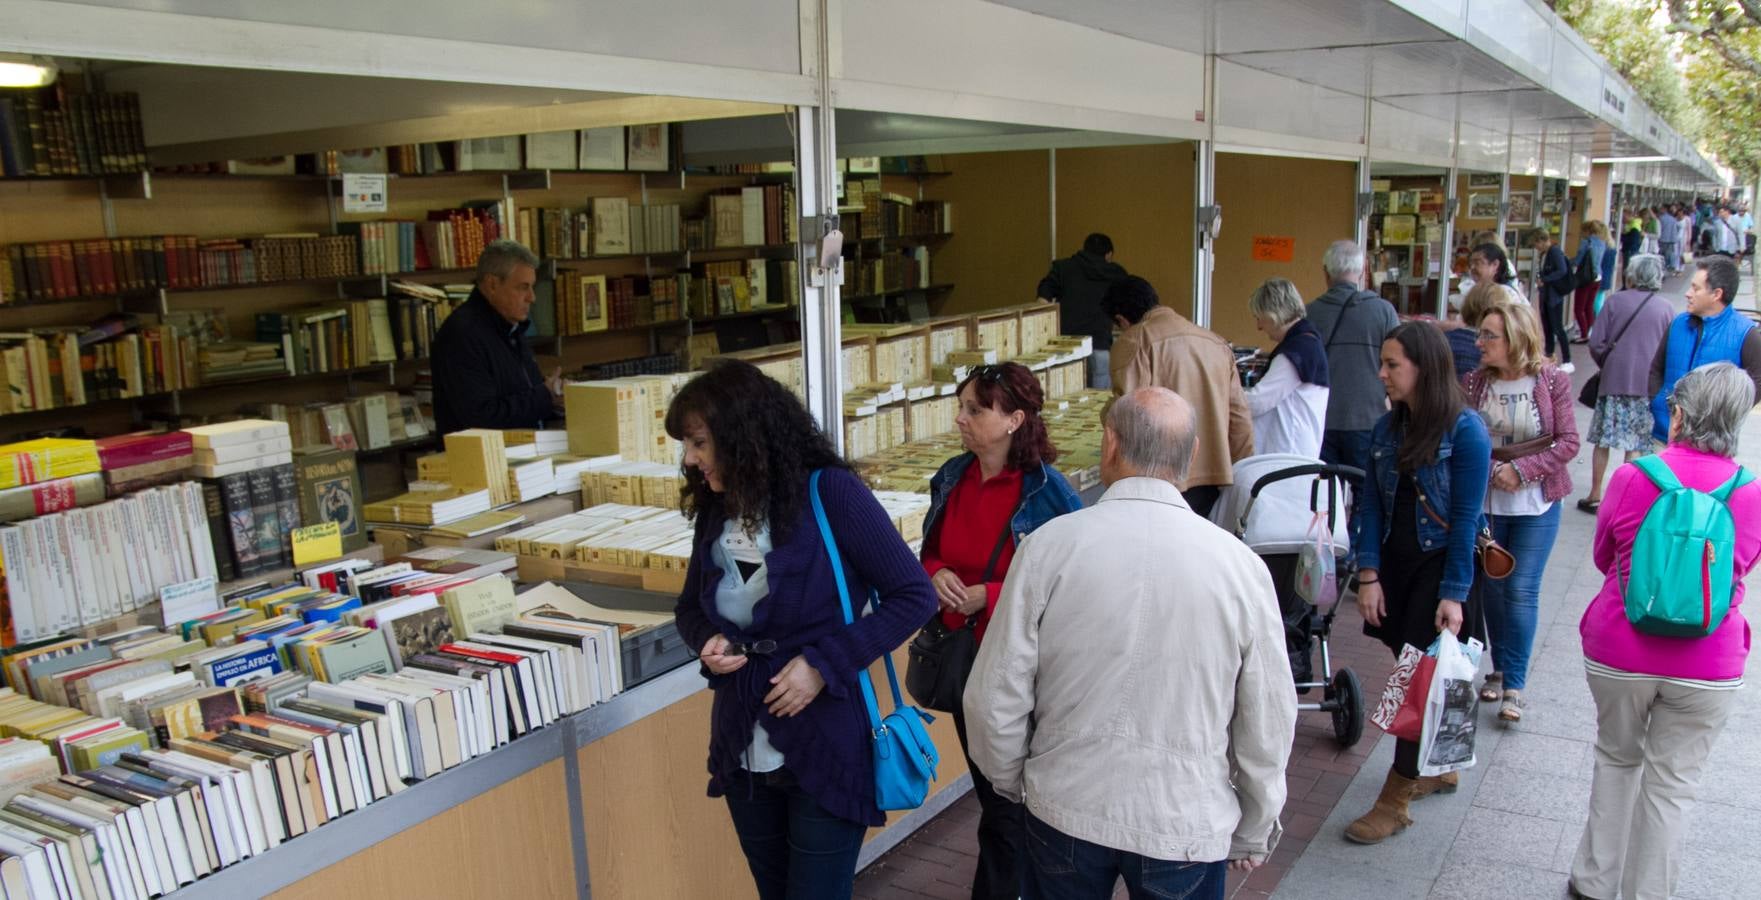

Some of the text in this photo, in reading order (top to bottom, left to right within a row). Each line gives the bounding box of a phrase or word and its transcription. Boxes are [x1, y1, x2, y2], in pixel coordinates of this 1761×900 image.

[214, 658, 247, 672] LA HISTORIA
[248, 653, 278, 669] AFRICA
